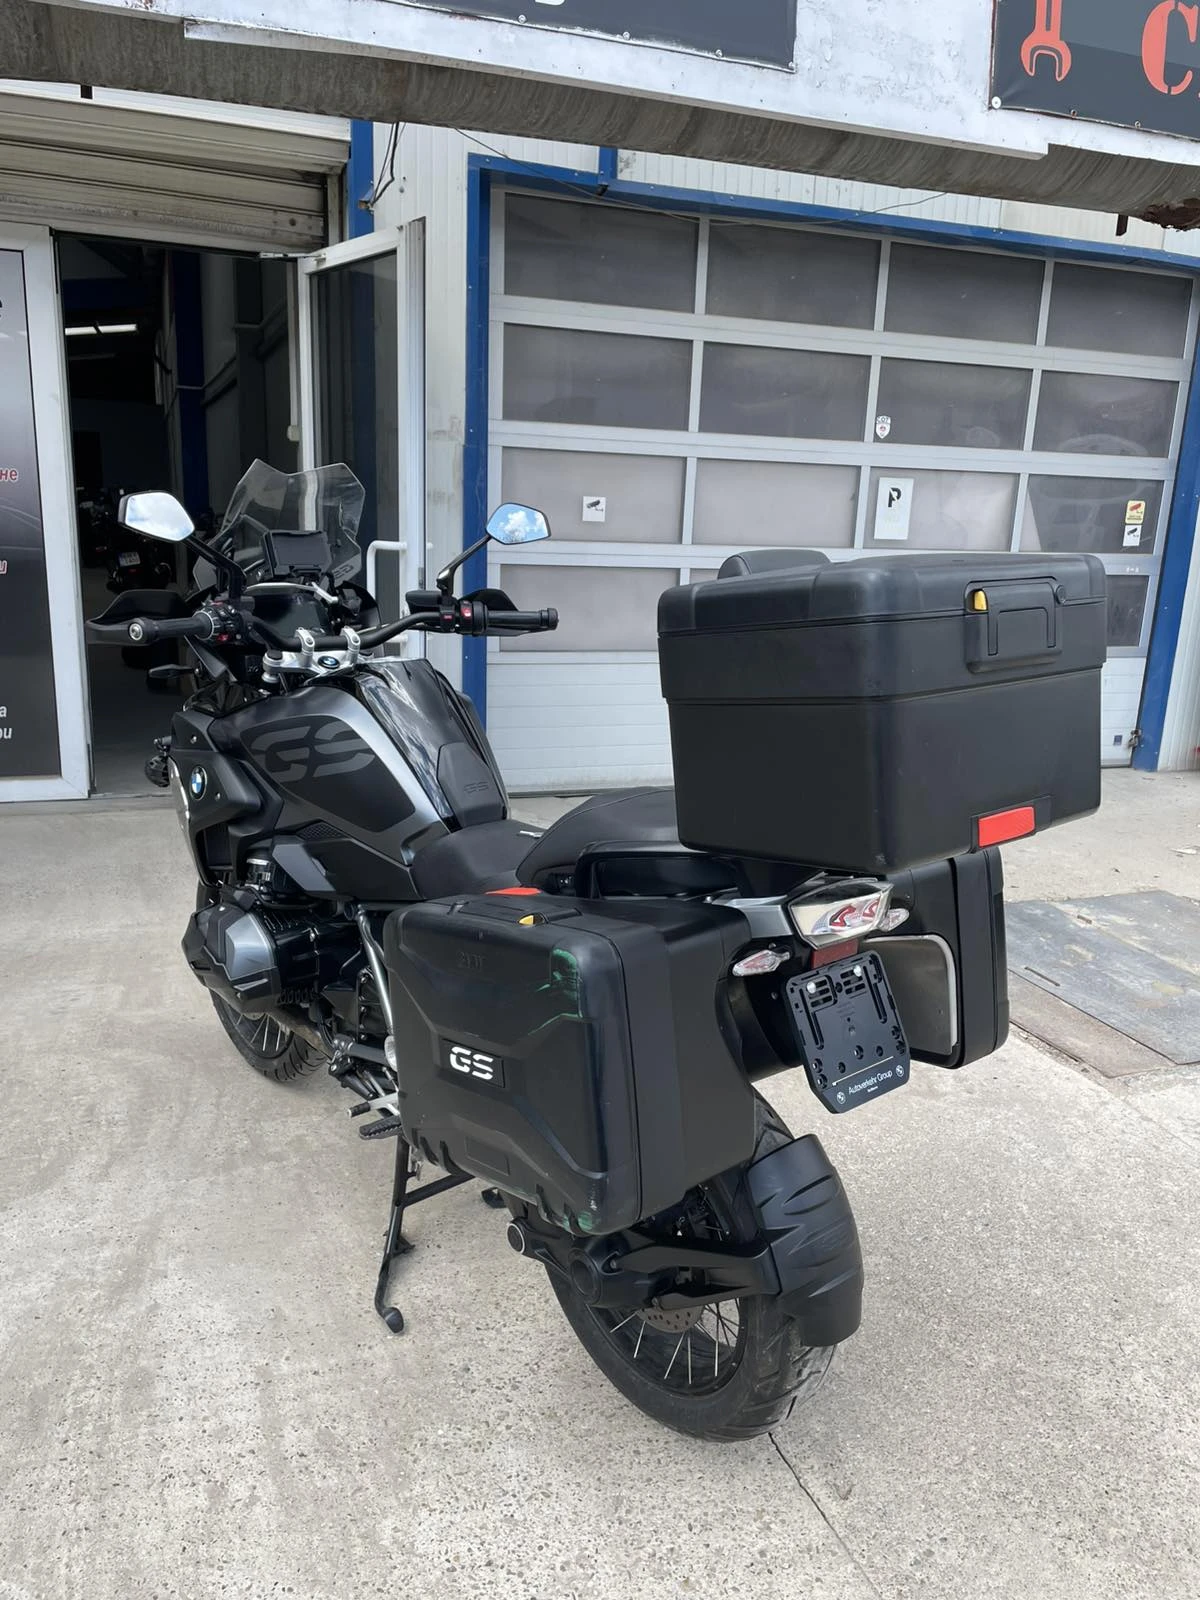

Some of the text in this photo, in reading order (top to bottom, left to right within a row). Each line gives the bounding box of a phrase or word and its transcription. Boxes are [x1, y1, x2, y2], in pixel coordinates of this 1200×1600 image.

[1141, 0, 1200, 98] C
[249, 720, 376, 784] GS
[449, 1046, 494, 1080] GS
[876, 1069, 893, 1082] Group
